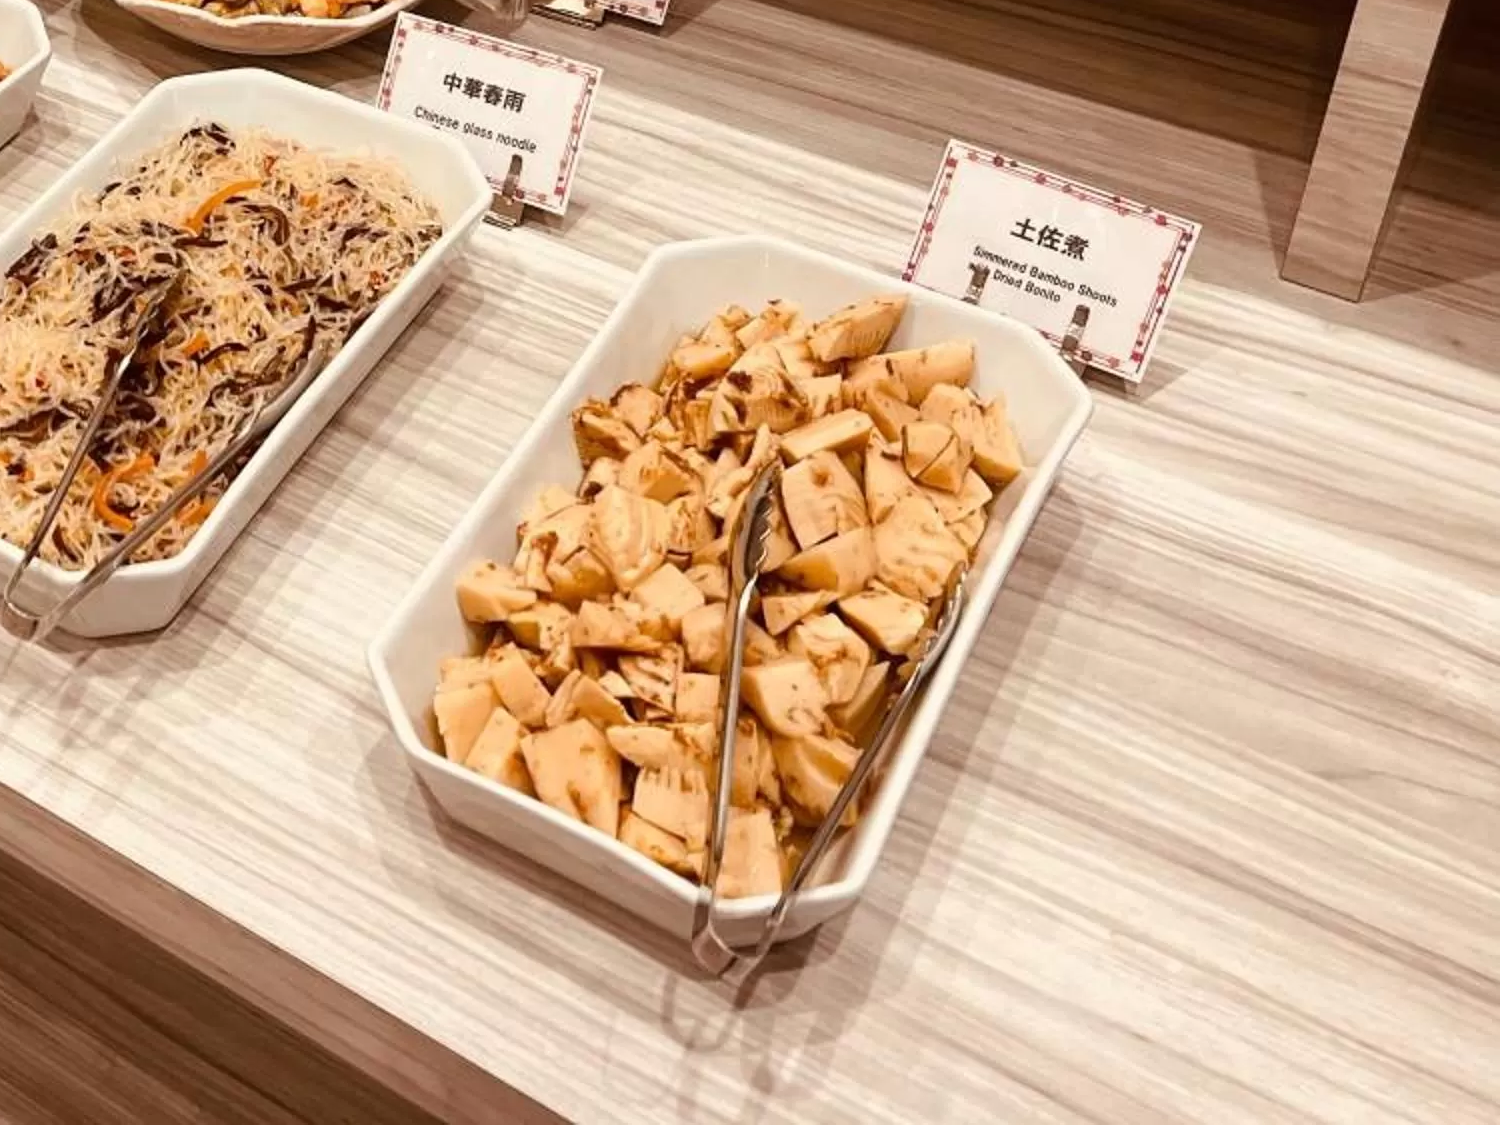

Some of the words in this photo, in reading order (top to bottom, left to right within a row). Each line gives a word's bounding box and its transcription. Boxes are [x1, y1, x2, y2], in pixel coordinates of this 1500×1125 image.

[443, 72, 526, 113] 中華春雨
[414, 106, 459, 130] Chinese
[463, 121, 493, 141] glass
[496, 131, 537, 154] noodle
[1010, 218, 1090, 261] 土佐煮
[973, 246, 1028, 274] Simmered
[1030, 266, 1075, 291] Bamboo
[1077, 284, 1118, 307] Shoots
[993, 269, 1023, 290] Dried
[1025, 280, 1061, 303] Bonito
